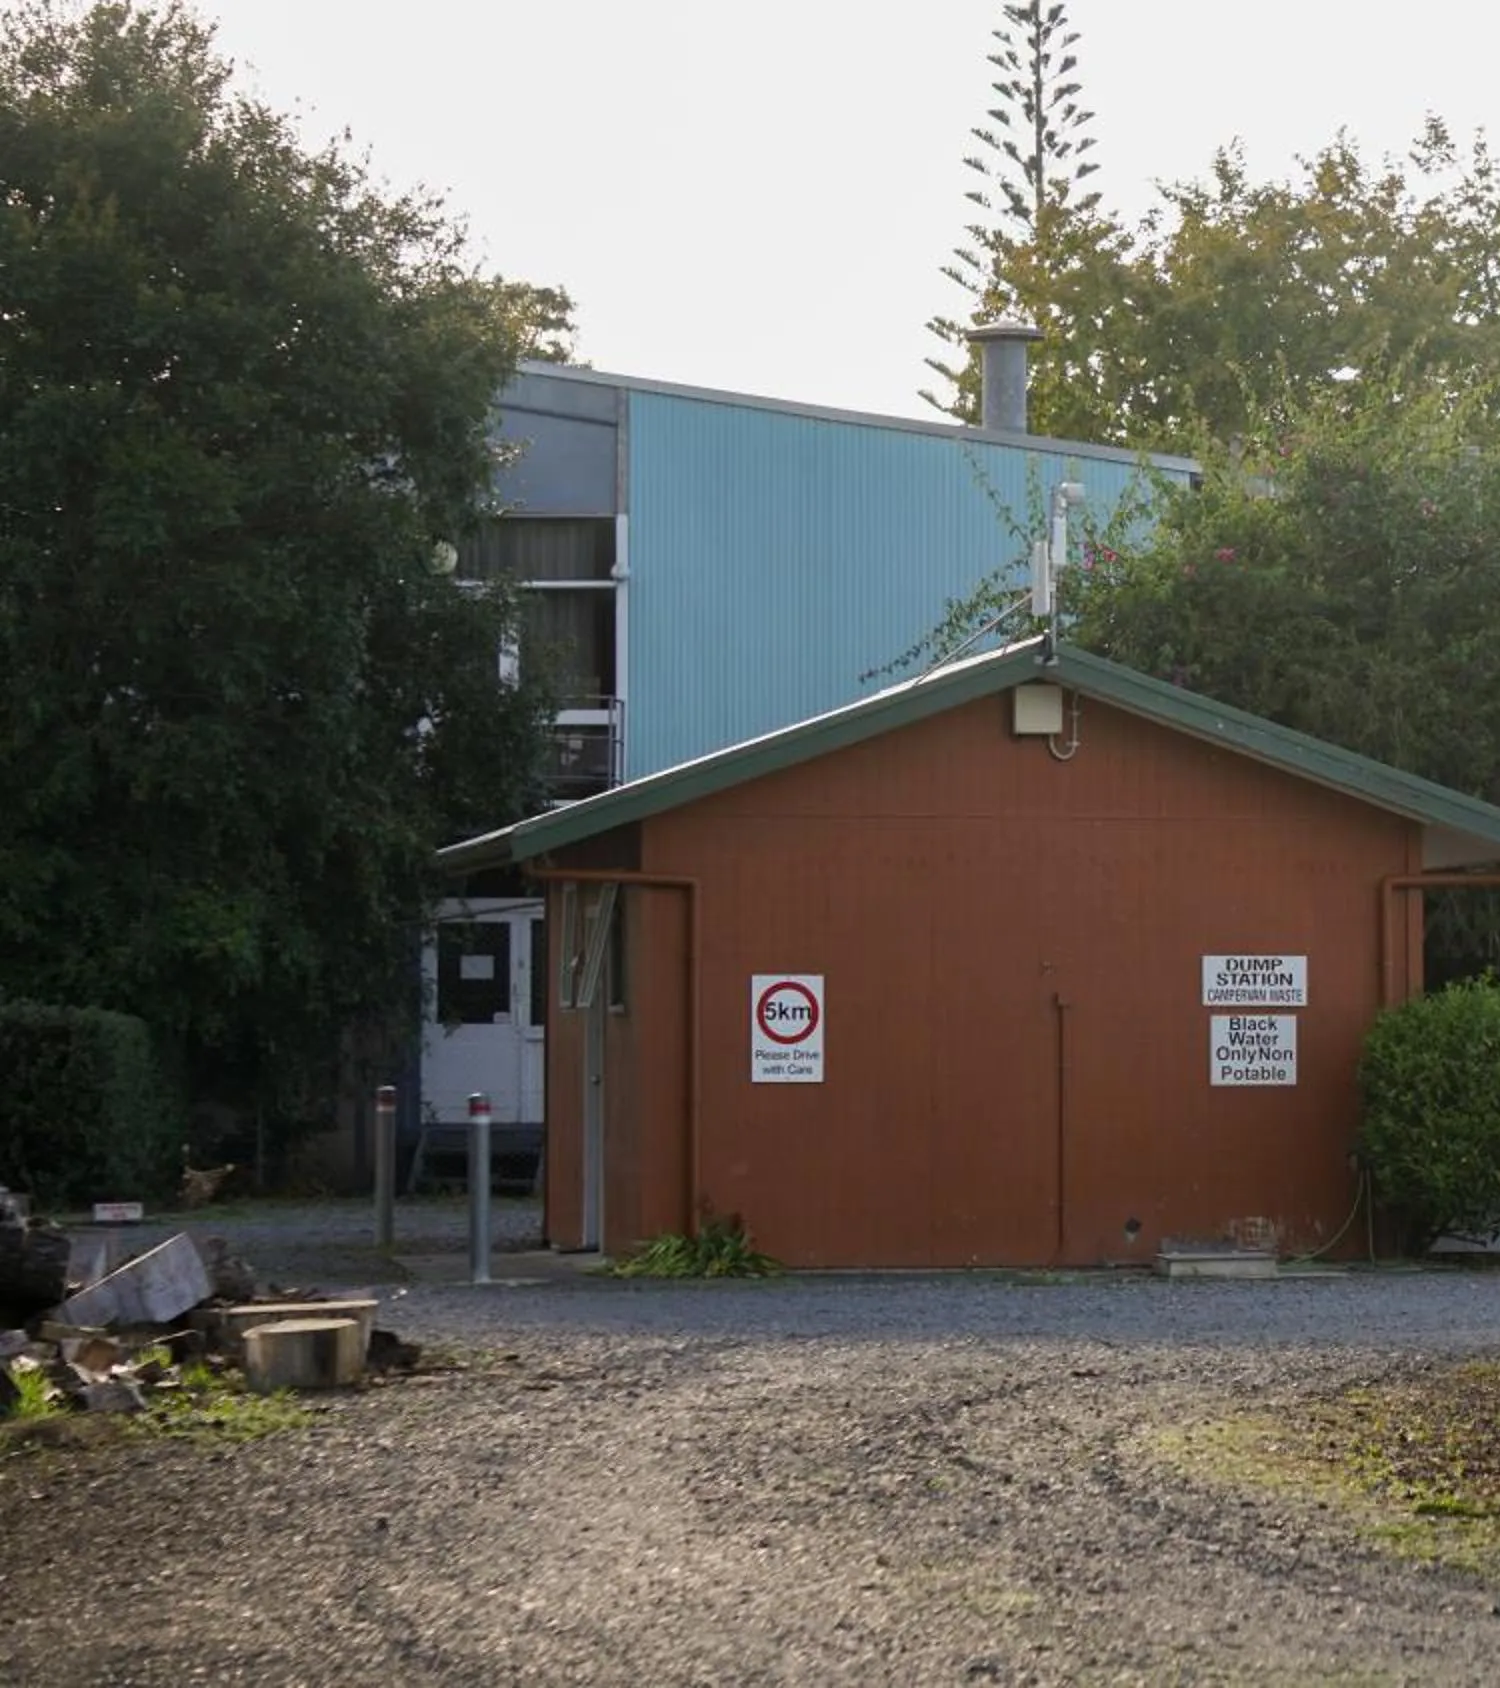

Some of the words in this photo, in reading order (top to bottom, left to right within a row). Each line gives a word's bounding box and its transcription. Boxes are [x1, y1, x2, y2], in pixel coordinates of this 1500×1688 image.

[1225, 958, 1283, 971] DUMP
[1216, 973, 1293, 986] STATION
[1207, 988, 1267, 1002] CAMPERVAN
[1269, 988, 1303, 1002] WASTE
[765, 1002, 811, 1020] 5km
[1229, 1017, 1278, 1031] Black
[1228, 1032, 1279, 1045] Water
[755, 1049, 790, 1060] Please
[793, 1049, 820, 1060] Drive
[763, 1064, 785, 1074] with
[1221, 1065, 1286, 1081] Potable
